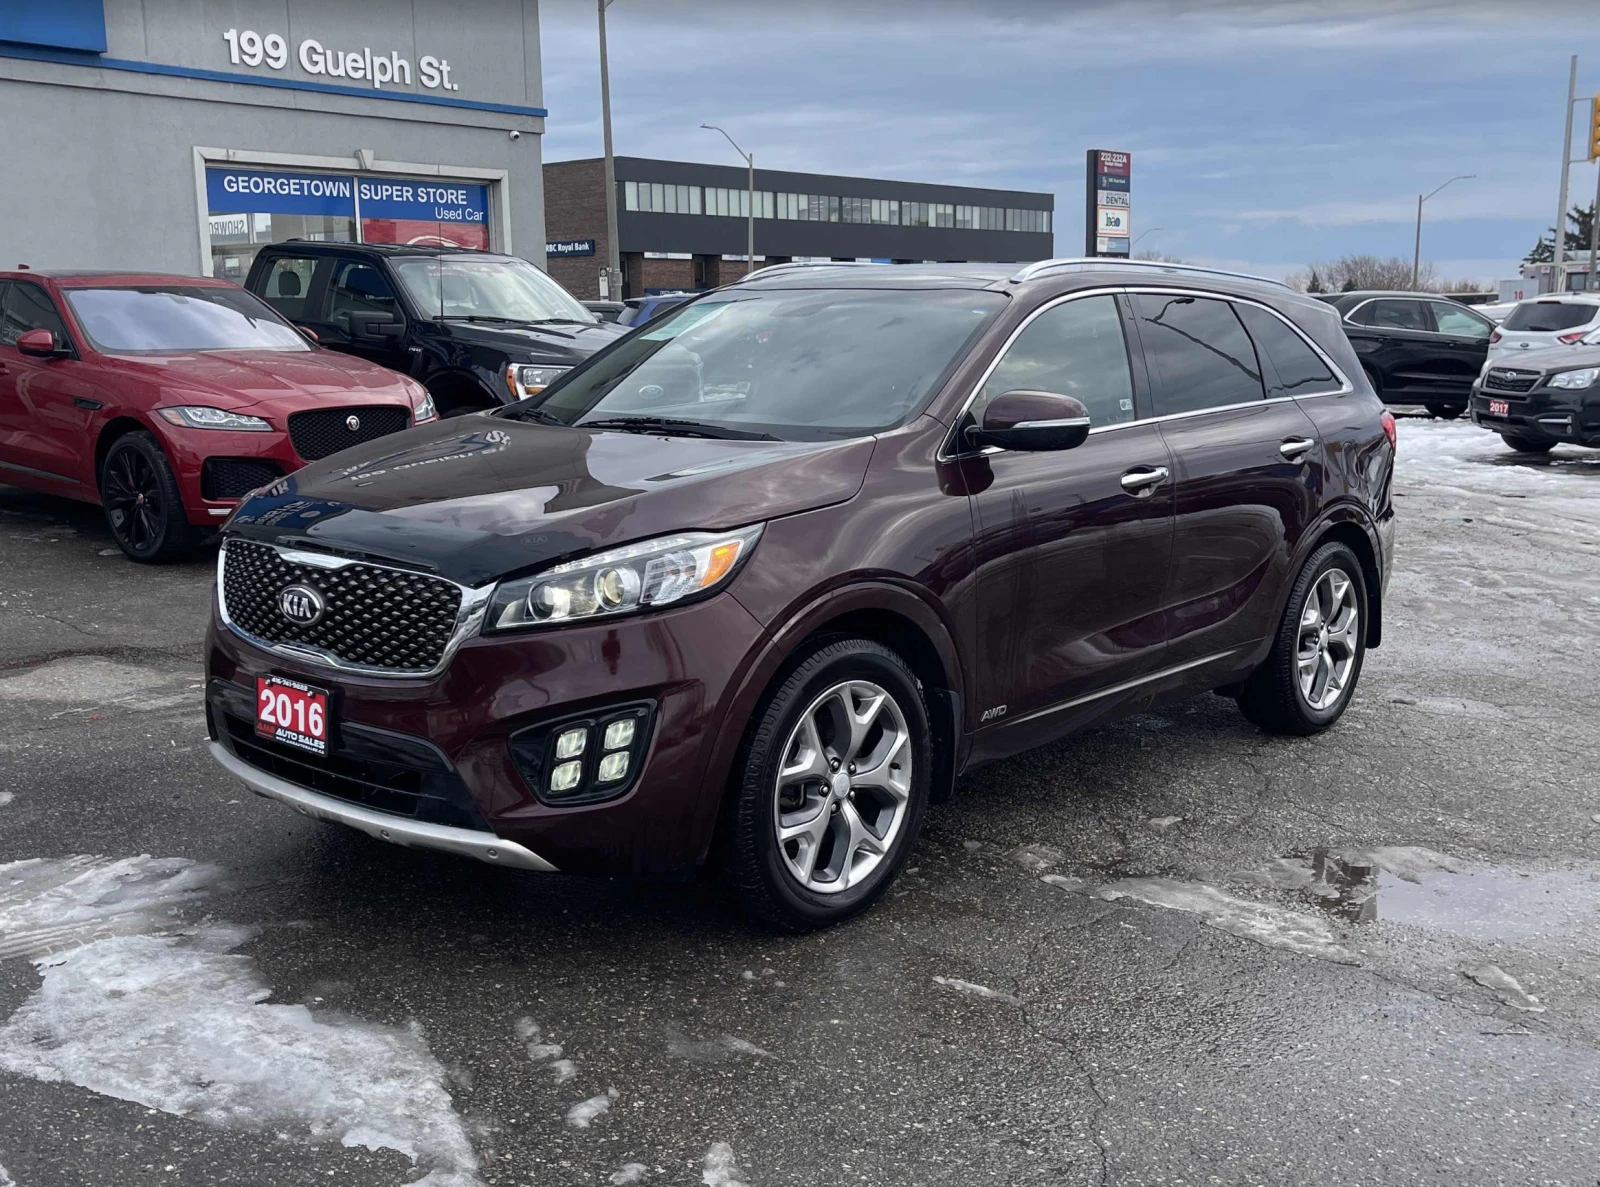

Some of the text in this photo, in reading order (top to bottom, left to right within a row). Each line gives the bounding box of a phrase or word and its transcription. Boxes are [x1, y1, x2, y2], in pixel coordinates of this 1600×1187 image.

[223, 28, 459, 91] 199 Guelph St.
[223, 175, 468, 205] GEORGETOWN SUPER STORE
[1105, 196, 1129, 206] DENTAL
[435, 206, 484, 221] Used Car
[545, 241, 589, 253] RBC Royal Bank
[1489, 402, 1509, 413] 2017
[283, 593, 312, 618] KIA
[260, 688, 323, 737] 2016
[980, 704, 1007, 722] AWD
[276, 728, 298, 741] AUTO
[298, 734, 325, 749] SALES
